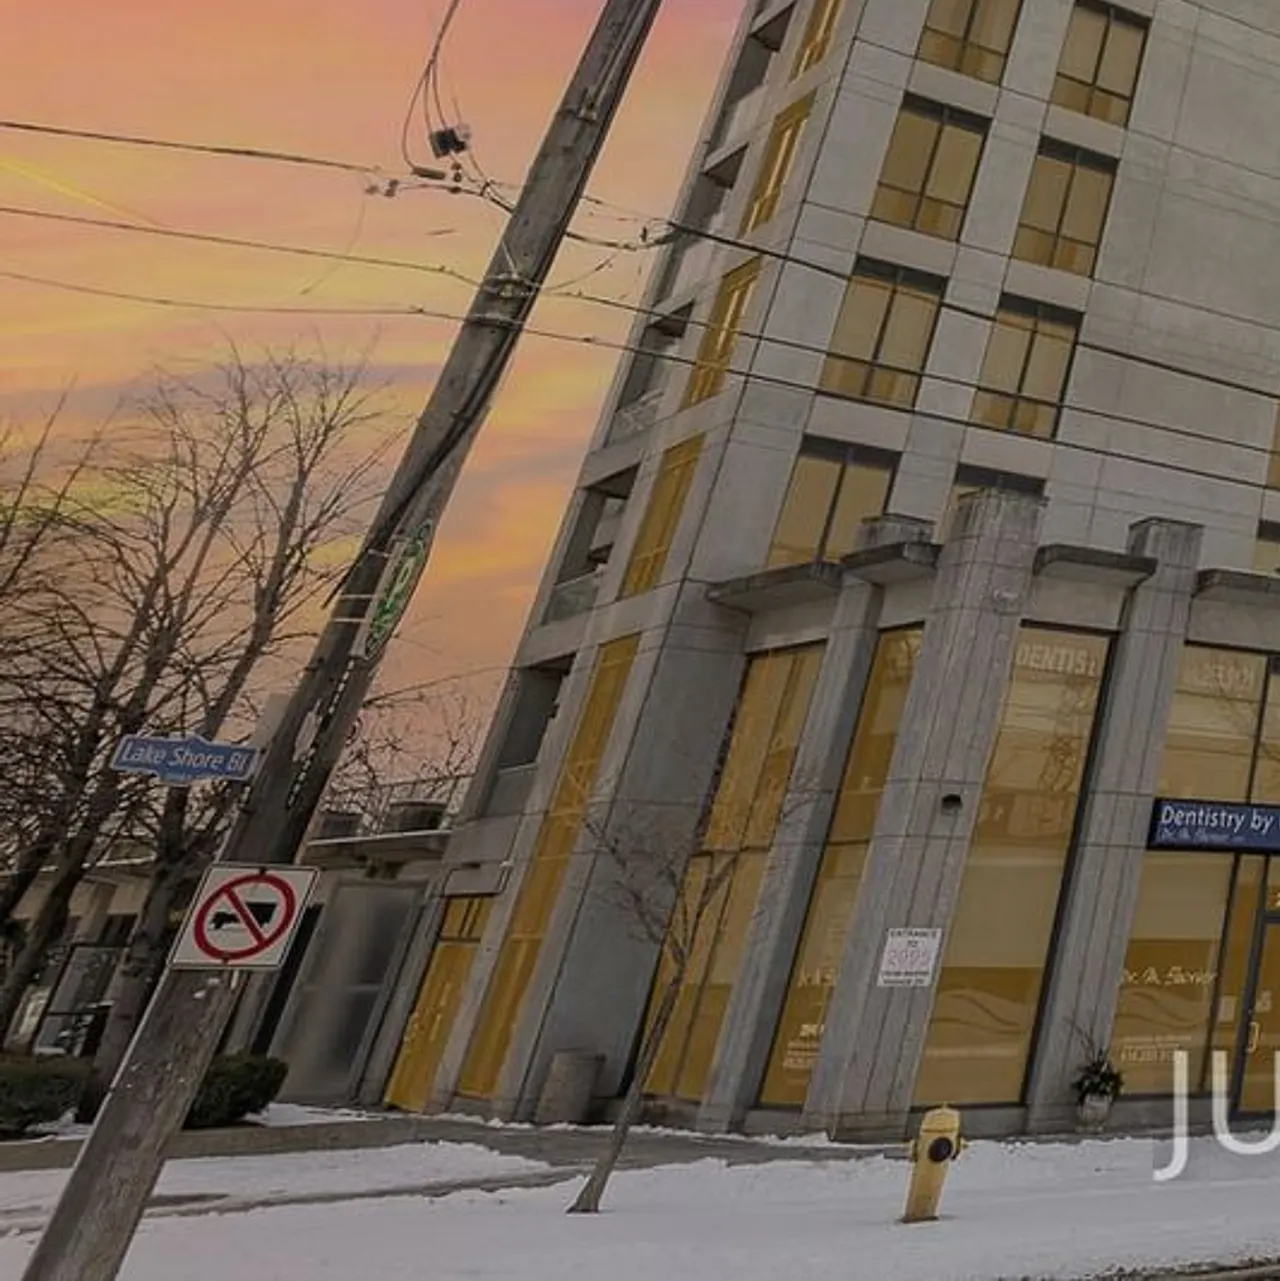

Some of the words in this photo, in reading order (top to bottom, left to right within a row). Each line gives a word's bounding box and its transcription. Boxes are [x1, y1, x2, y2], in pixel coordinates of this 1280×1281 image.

[121, 741, 167, 764] Lake
[168, 747, 225, 769] Shore
[1160, 805, 1246, 833] Dentistry
[1250, 810, 1273, 835] by
